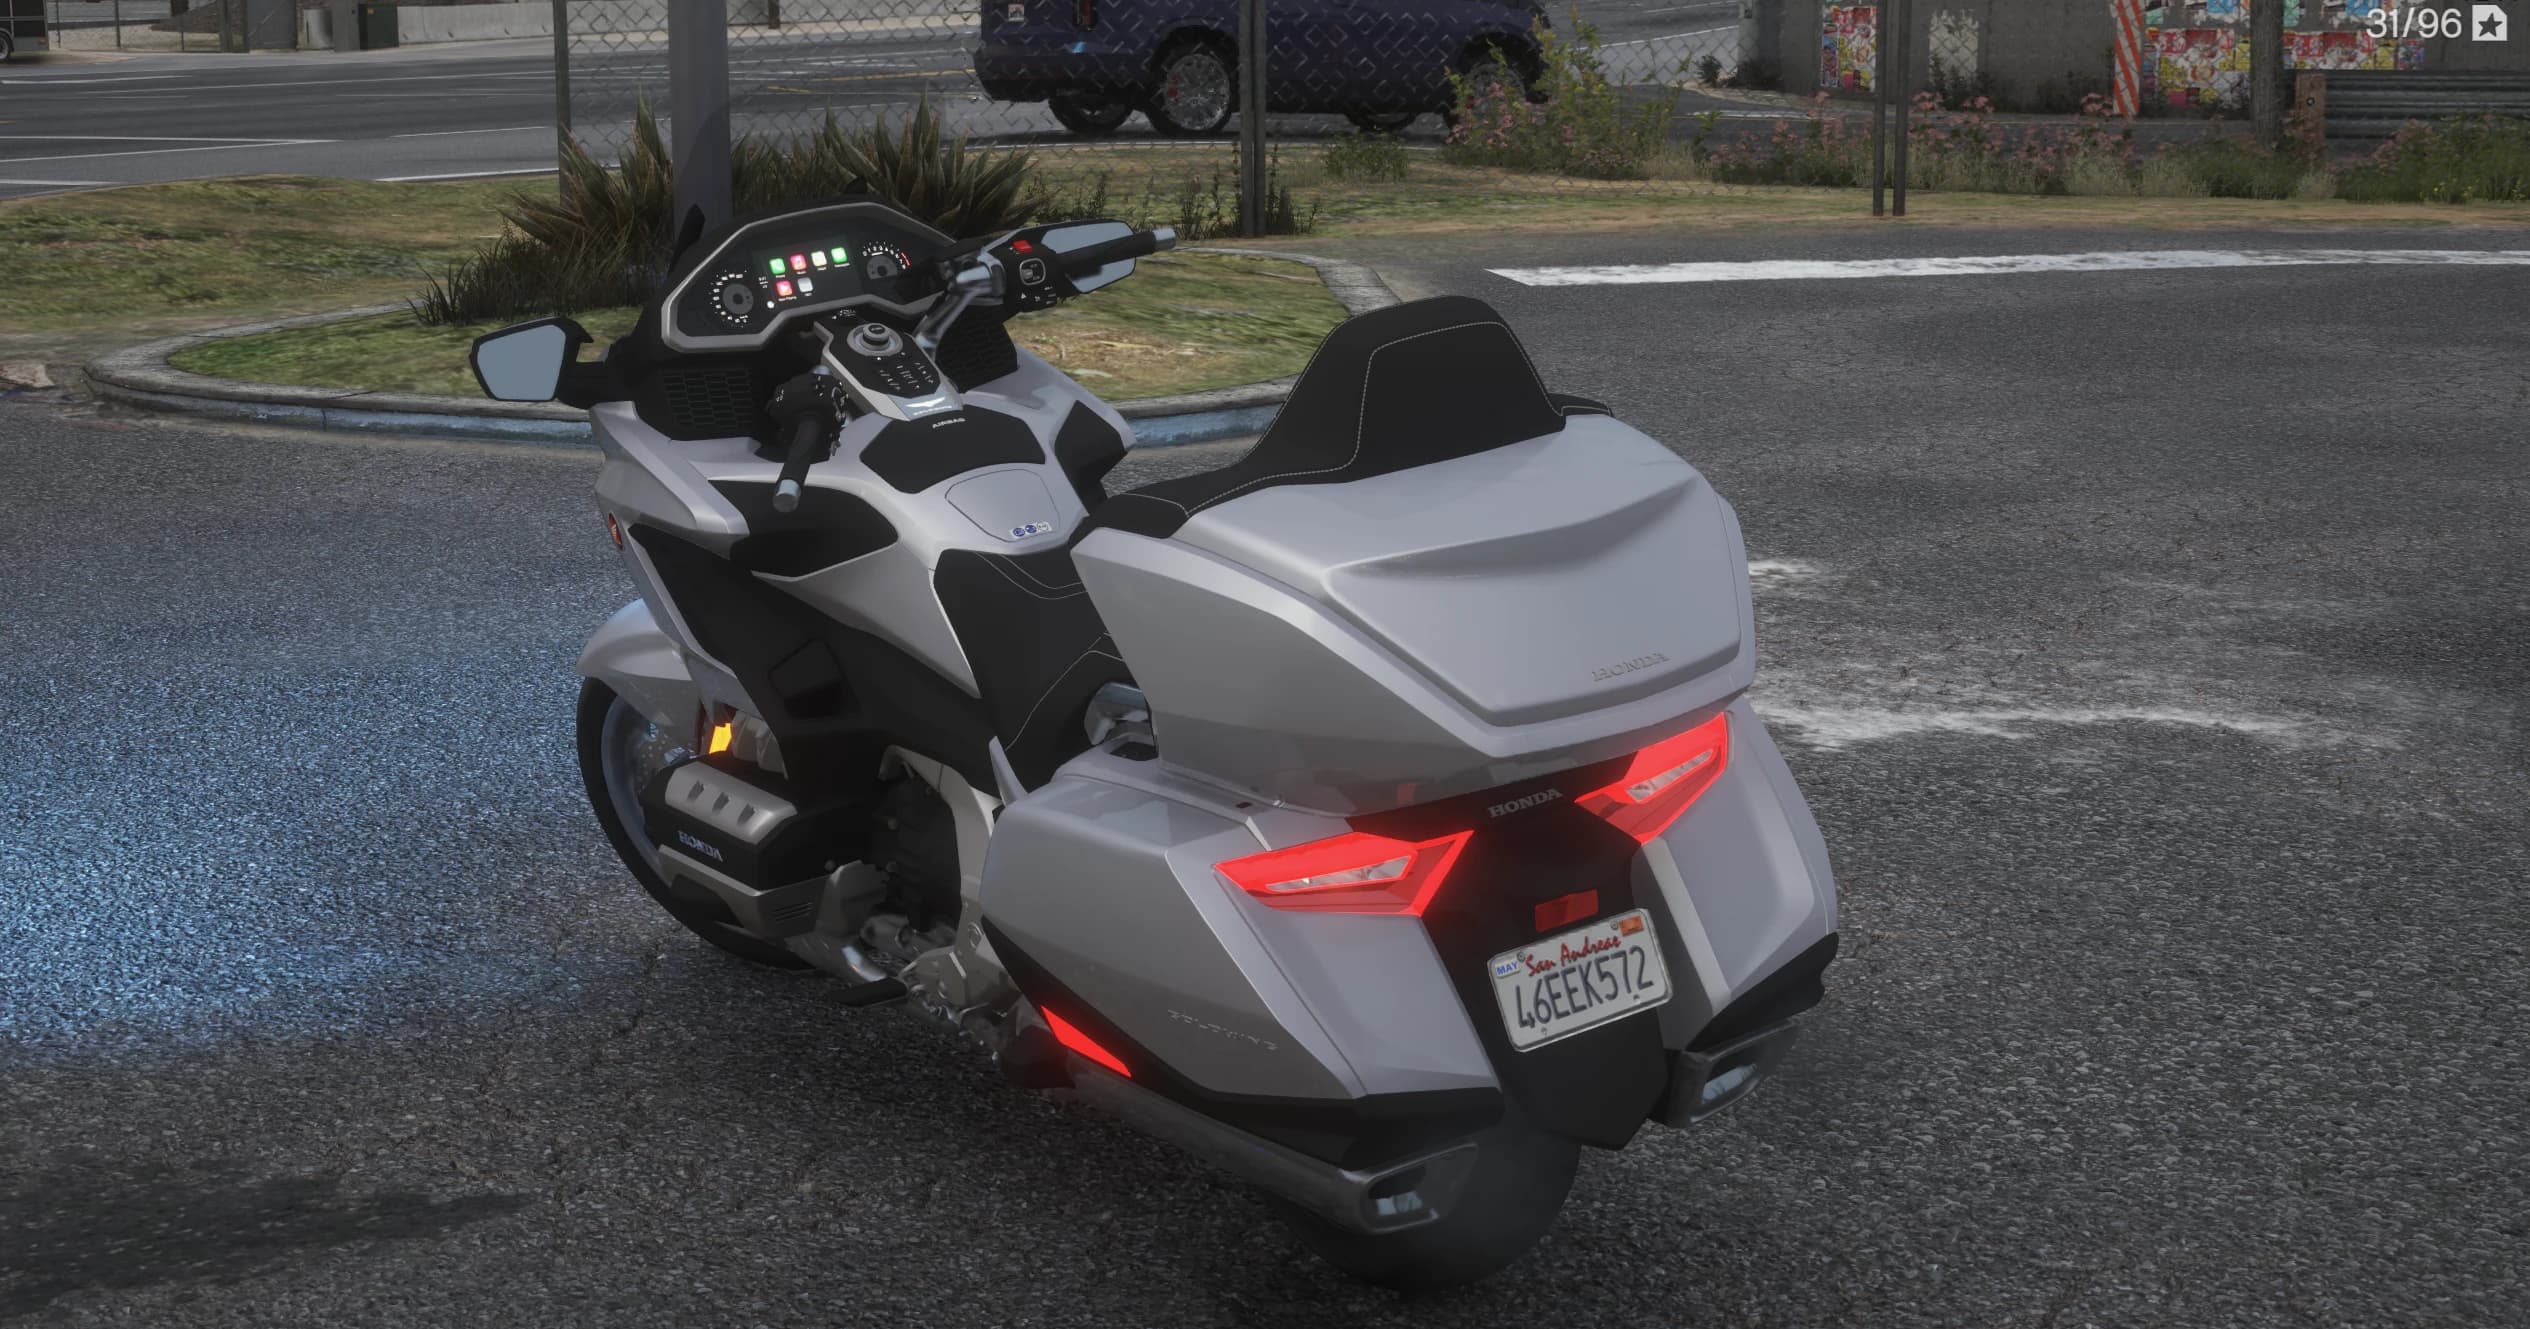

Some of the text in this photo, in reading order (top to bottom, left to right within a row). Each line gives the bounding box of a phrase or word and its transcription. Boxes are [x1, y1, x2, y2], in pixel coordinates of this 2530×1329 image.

[1591, 652, 1671, 682] HONDA
[1488, 788, 1563, 818] HONDA
[677, 830, 724, 862] HONDA
[1495, 961, 1519, 975] MAY
[1524, 935, 1622, 977] San Andreas
[1515, 945, 1654, 1029] 46EEK572
